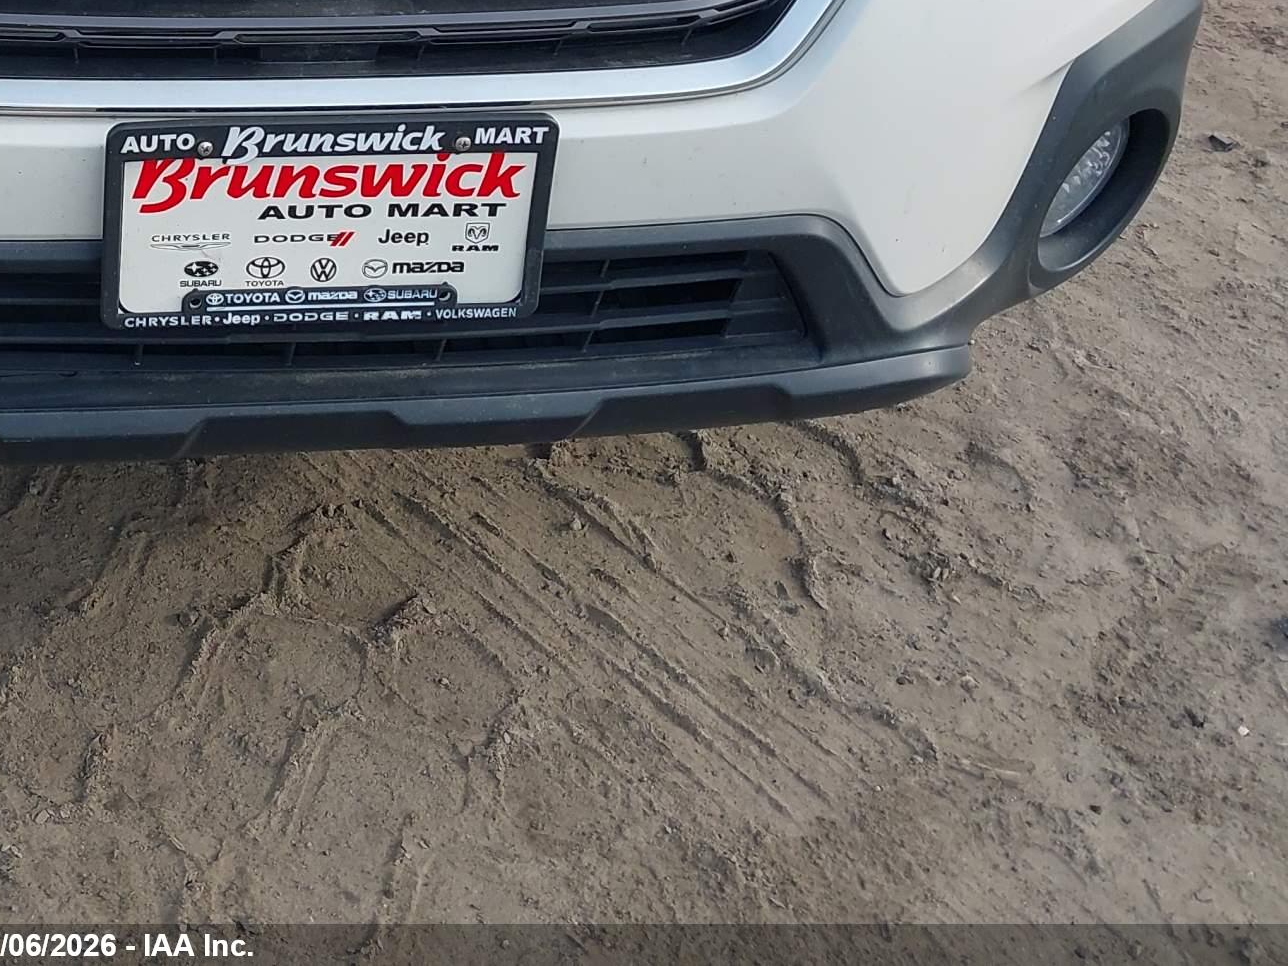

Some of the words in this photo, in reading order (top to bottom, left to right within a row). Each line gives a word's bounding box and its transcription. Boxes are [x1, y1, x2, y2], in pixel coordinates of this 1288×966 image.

[120, 133, 195, 153] AUTO
[221, 124, 445, 164] Brunswick
[474, 127, 549, 145] MART
[132, 151, 526, 213] Brunswick
[257, 203, 372, 220] AUTO
[387, 203, 507, 218] MART
[151, 233, 231, 242] CHRYSLER
[254, 233, 340, 244] DODGE
[378, 228, 430, 247] Jeep
[451, 244, 500, 252] RAM
[179, 279, 223, 288] SUBARU
[225, 292, 281, 303] TOYOTA
[387, 289, 439, 300] SUBARU
[124, 315, 213, 328] CHRYSLER
[222, 312, 261, 327] Jeep
[273, 312, 350, 323] DODGE
[363, 310, 423, 321] RAM
[435, 307, 518, 320] VOLKSWAGEN
